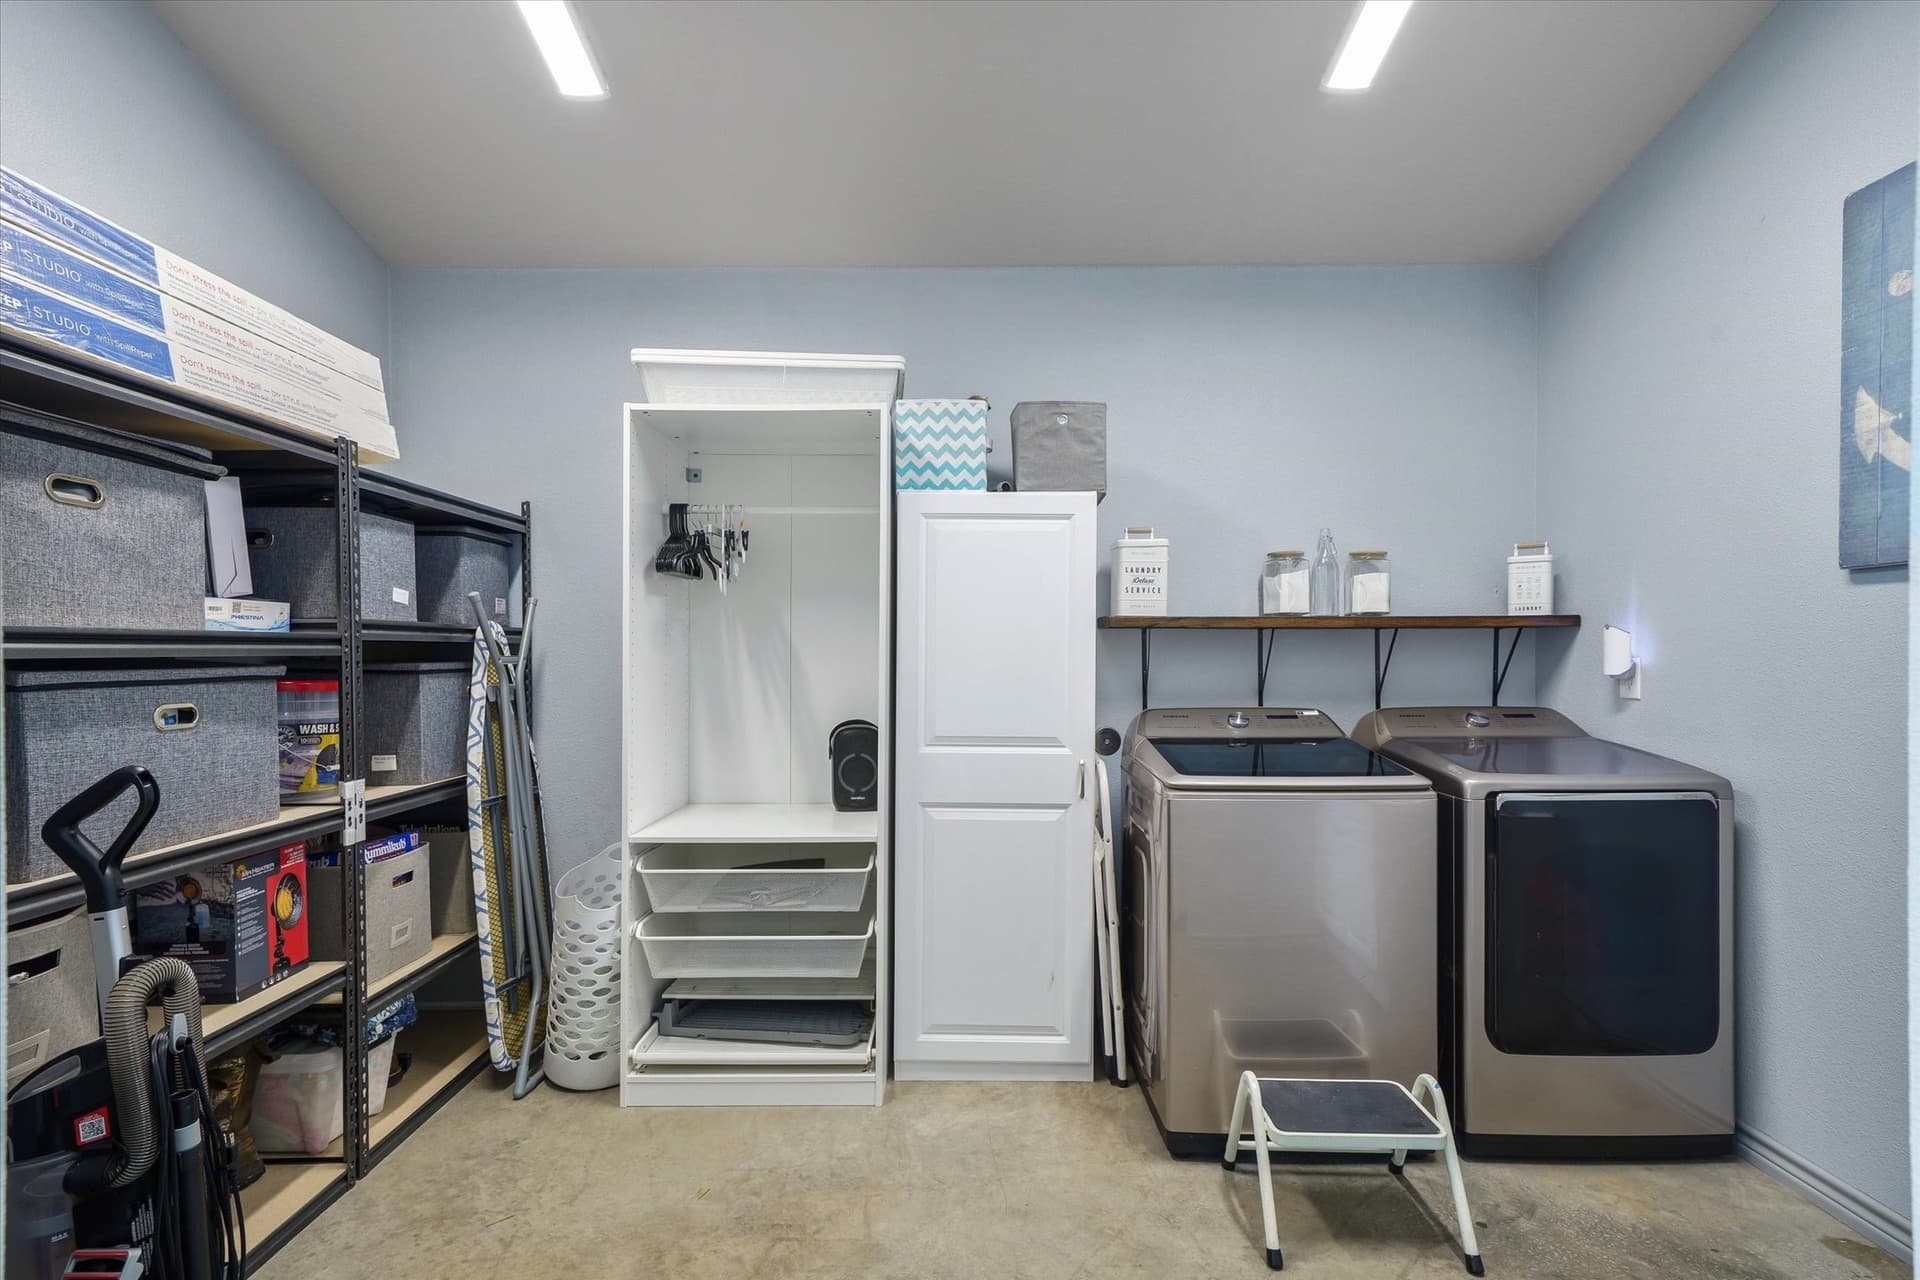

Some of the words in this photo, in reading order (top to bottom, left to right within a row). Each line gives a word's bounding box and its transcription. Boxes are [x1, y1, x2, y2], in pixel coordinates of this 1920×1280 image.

[23, 249, 81, 282] STUDIO
[32, 306, 90, 336] STUDIO
[180, 354, 205, 371] Don't
[1125, 586, 1161, 594] SERVICE
[299, 723, 329, 735] WASH
[329, 723, 335, 733] &
